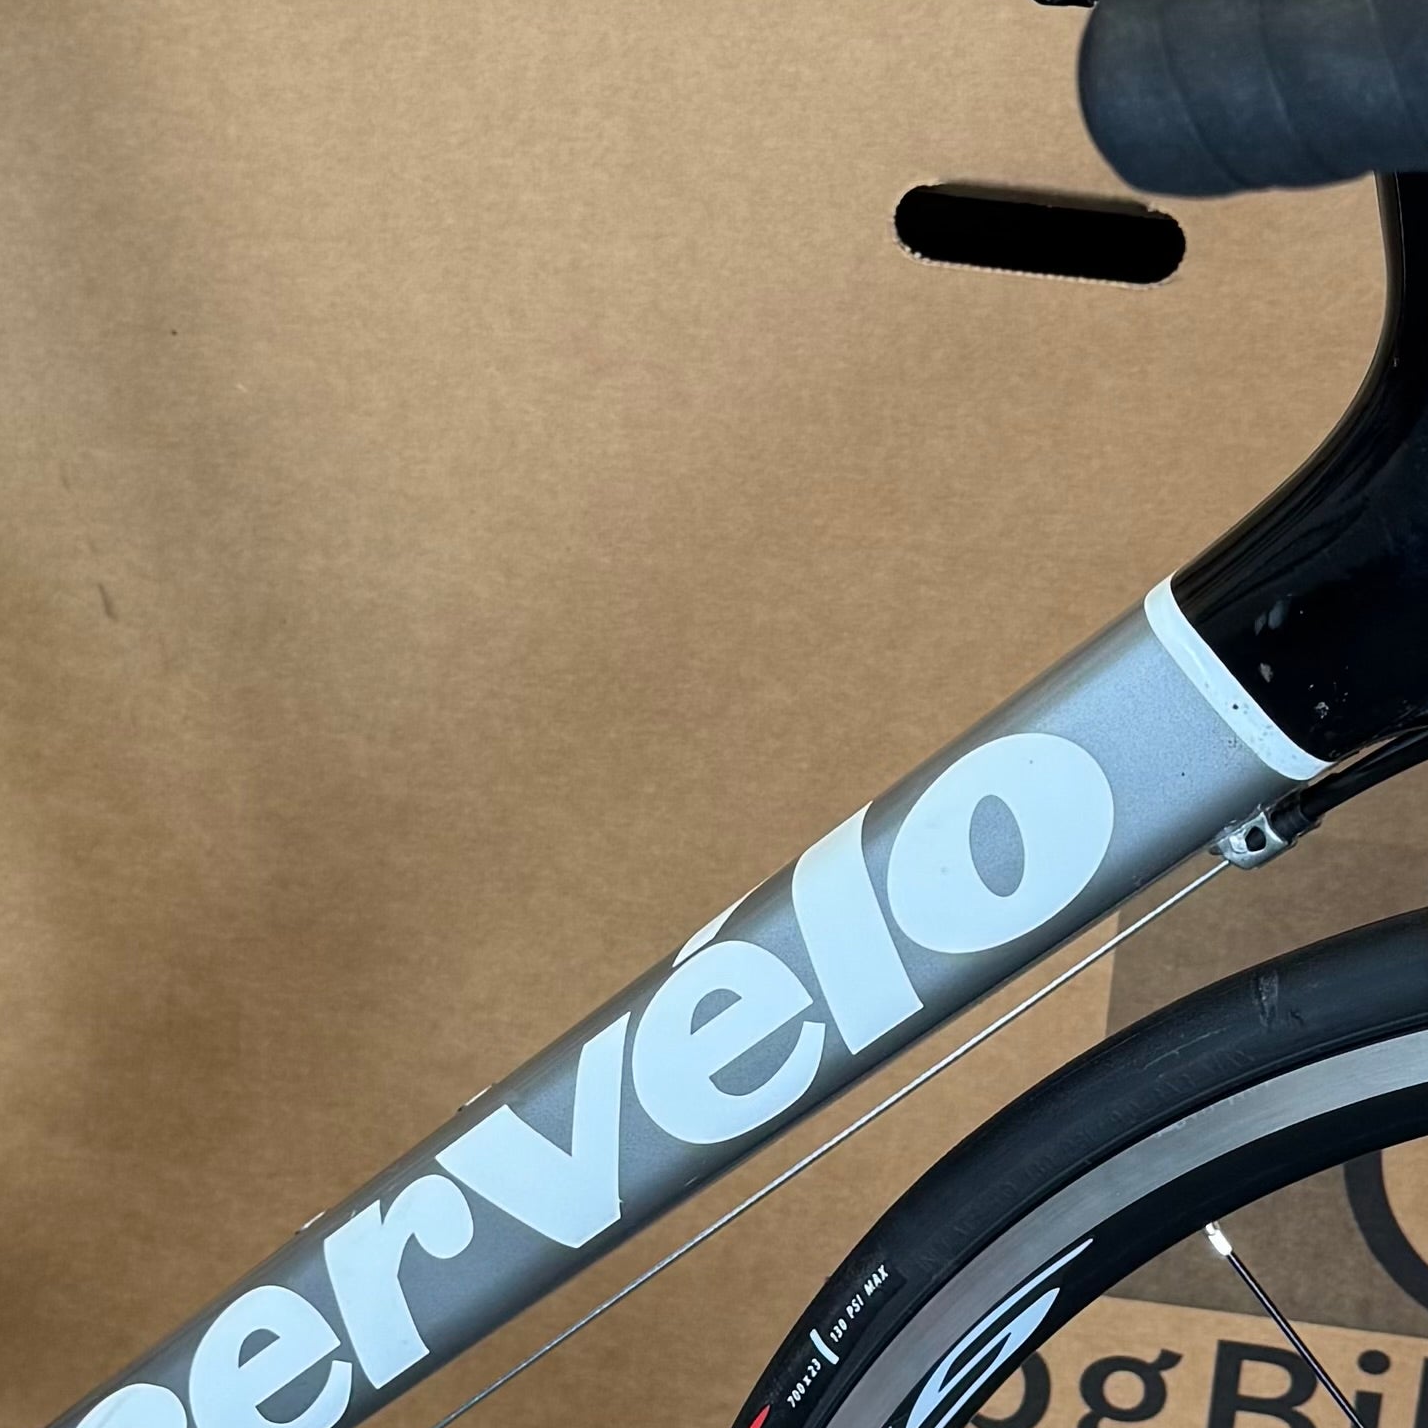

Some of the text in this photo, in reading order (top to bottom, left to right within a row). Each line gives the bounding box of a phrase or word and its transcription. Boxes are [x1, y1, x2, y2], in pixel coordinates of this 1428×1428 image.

[829, 1318, 848, 1343] 130
[845, 1293, 864, 1319] PSI
[863, 1264, 889, 1297] MAX
